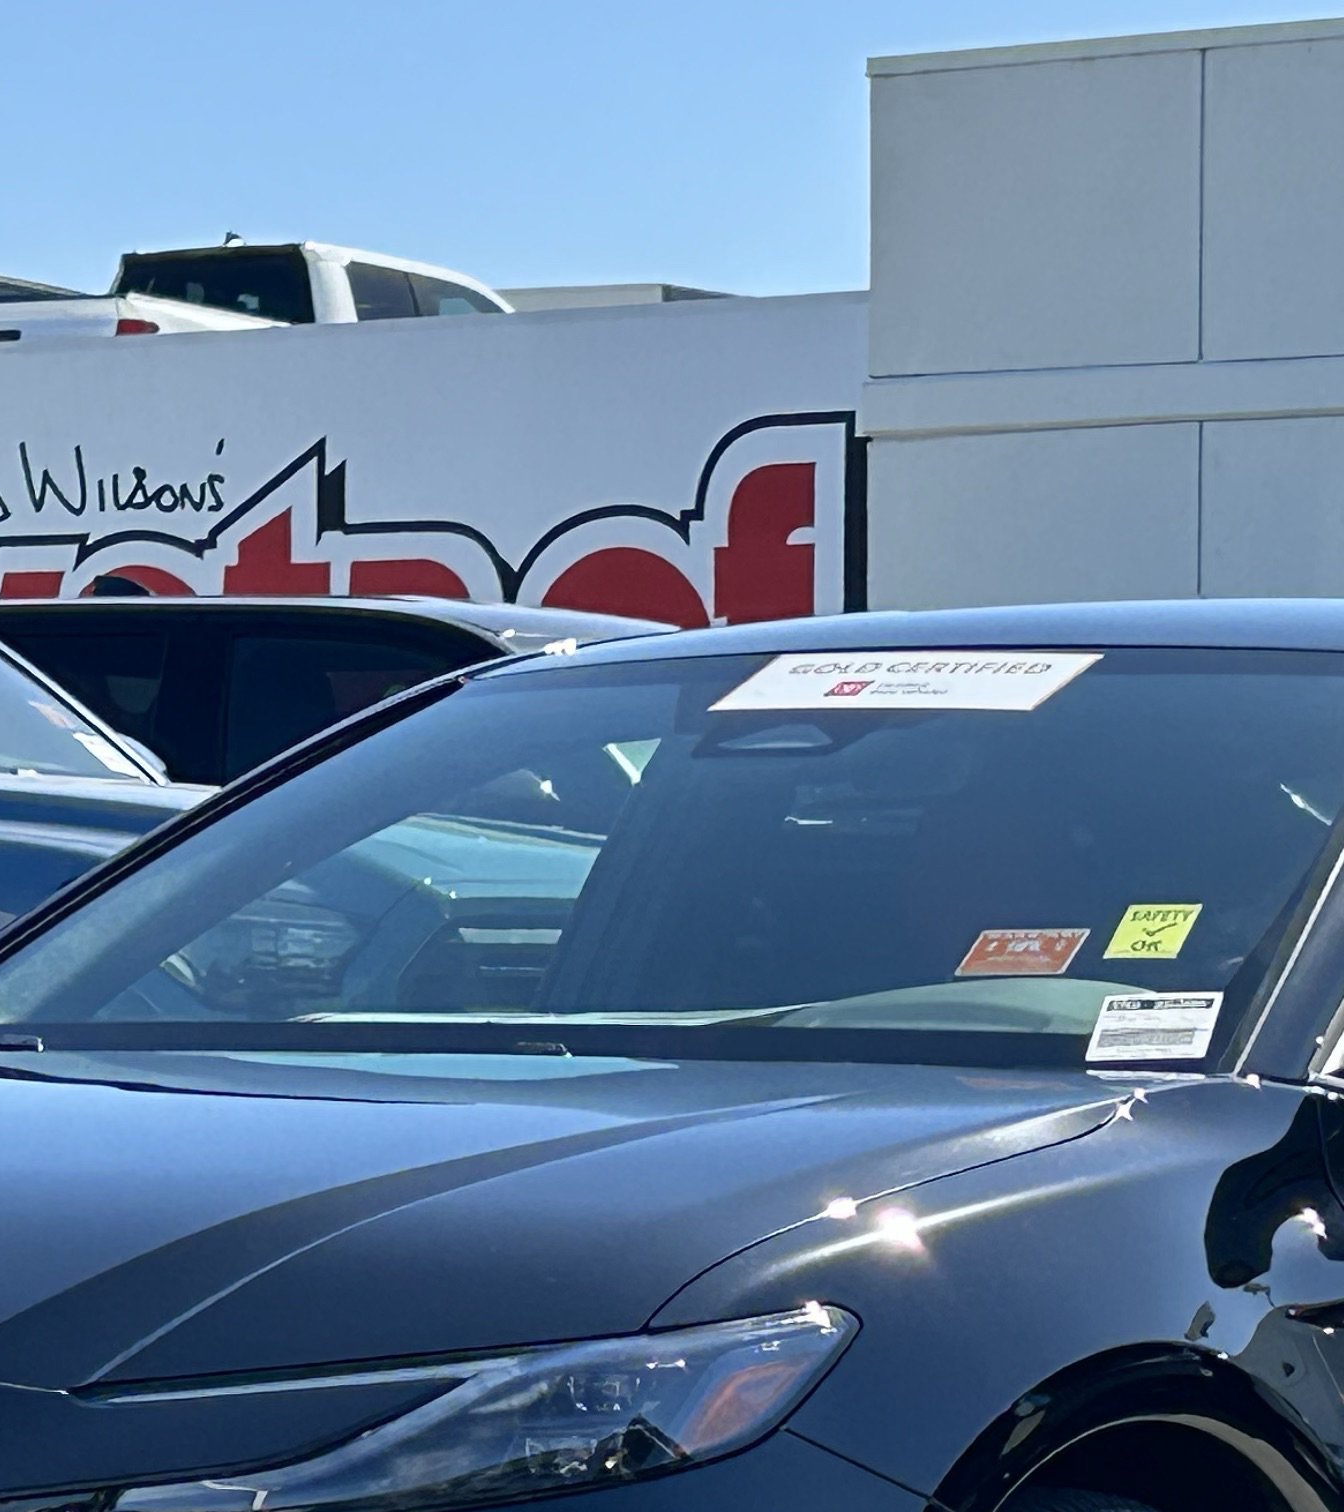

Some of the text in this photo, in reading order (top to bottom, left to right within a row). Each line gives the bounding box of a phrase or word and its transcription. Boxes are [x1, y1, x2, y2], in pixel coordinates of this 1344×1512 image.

[788, 661, 1053, 675] GOLD CERTIFIED
[1130, 909, 1195, 922] SAFETY
[1130, 939, 1163, 953] OK
